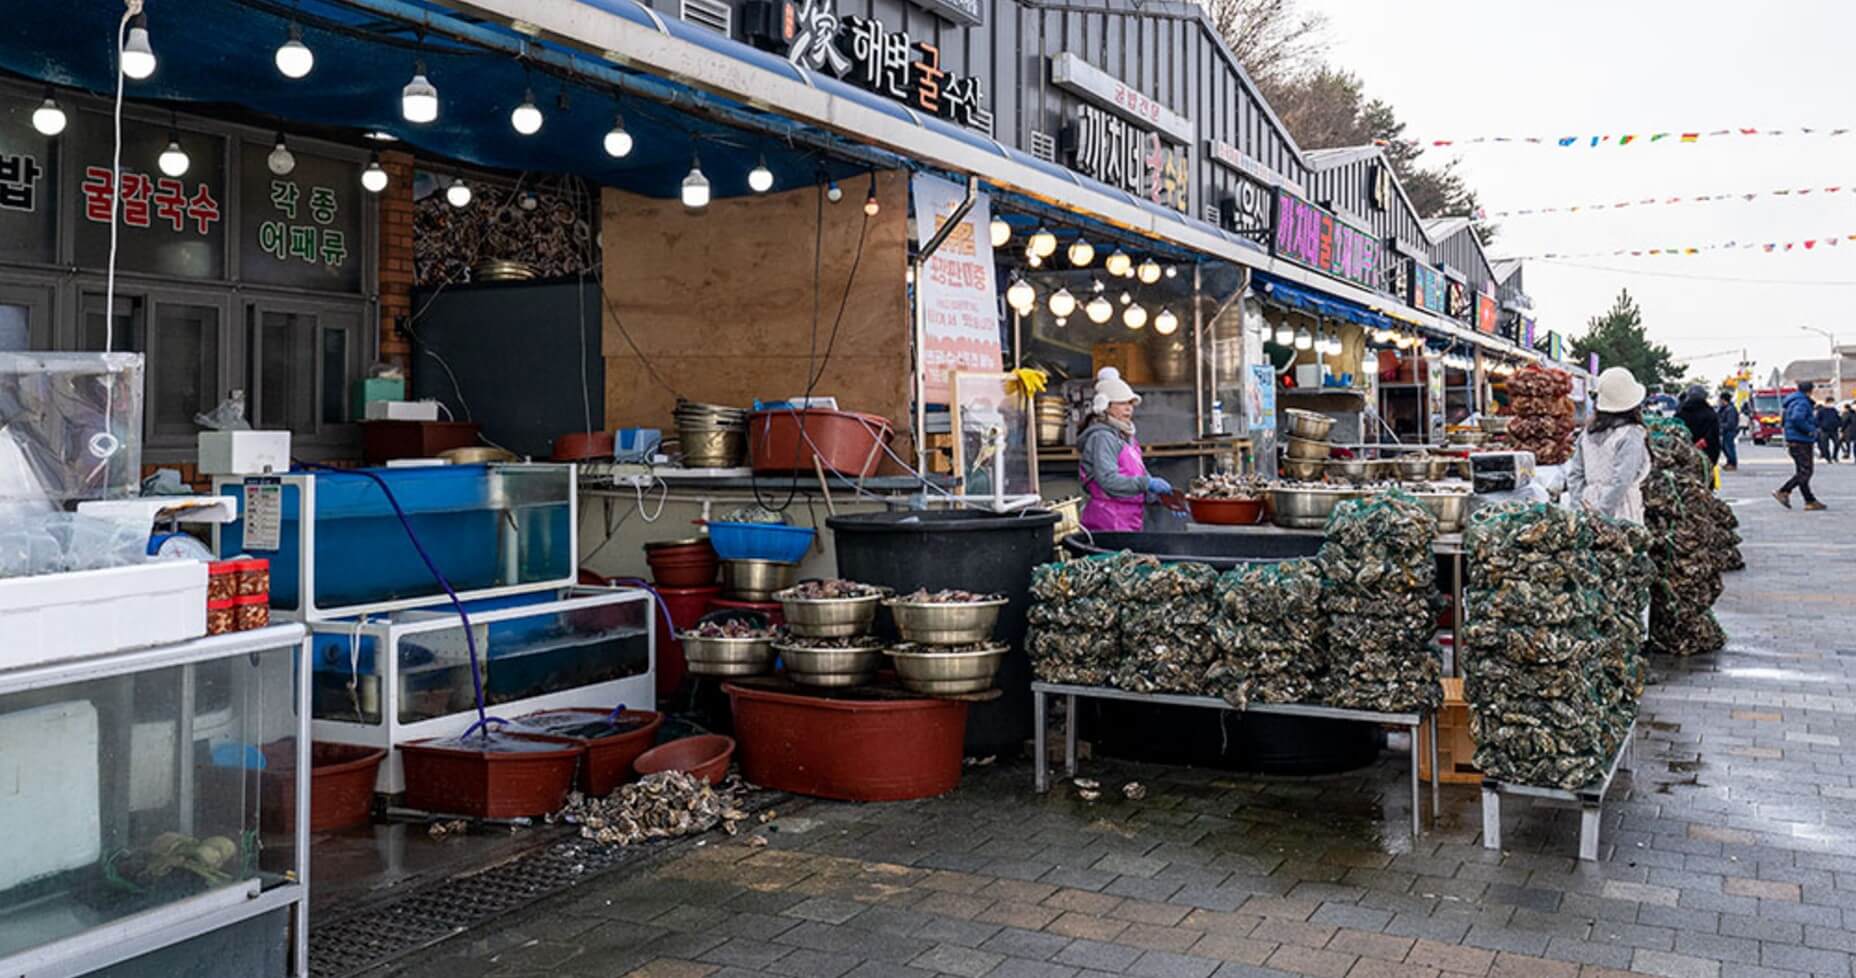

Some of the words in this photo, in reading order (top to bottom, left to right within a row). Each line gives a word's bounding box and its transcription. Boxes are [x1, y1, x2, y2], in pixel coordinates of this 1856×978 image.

[853, 15, 985, 125] 해변굴수산
[0, 155, 42, 212] 밥
[82, 166, 219, 234] 굴칼국수
[259, 221, 347, 266] 어패류
